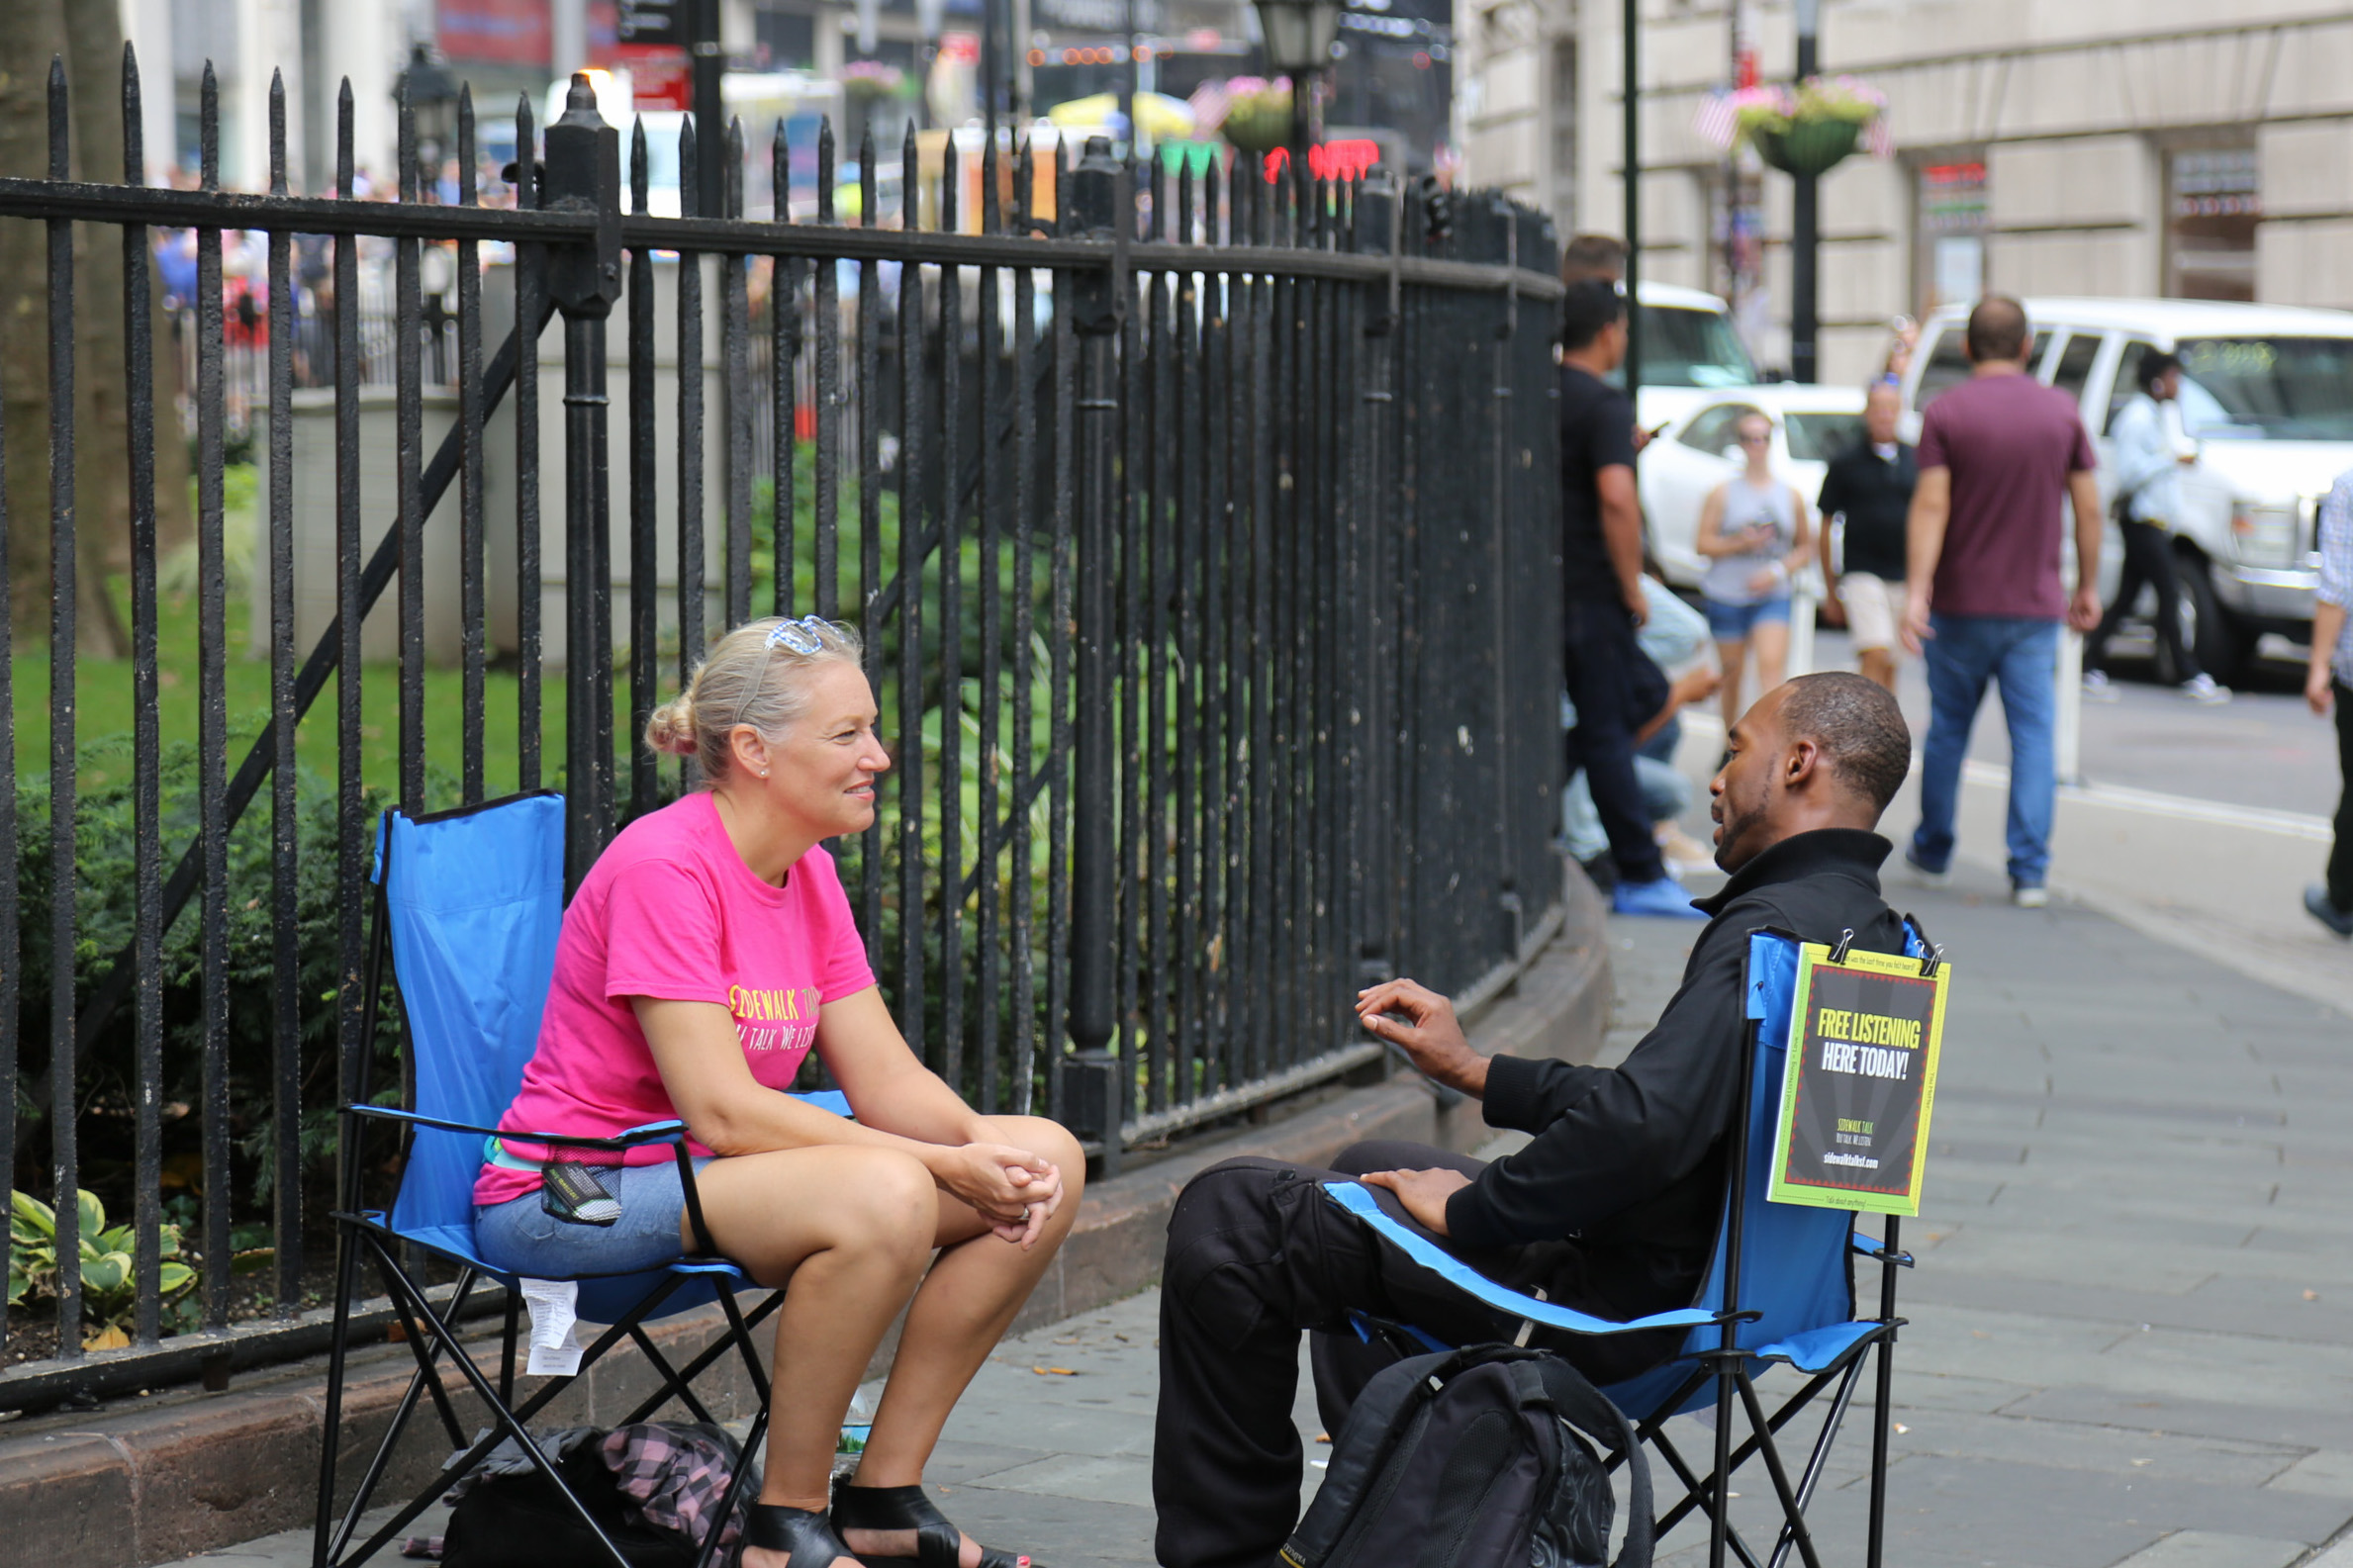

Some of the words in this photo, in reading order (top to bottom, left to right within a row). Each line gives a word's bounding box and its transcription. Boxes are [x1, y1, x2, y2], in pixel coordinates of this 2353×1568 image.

[728, 984, 800, 1021] SIDEWALK
[749, 1027, 778, 1051] TALK
[780, 1024, 796, 1051] WE
[1817, 1008, 1851, 1041] FREE
[1851, 1012, 1922, 1049] LISTENING
[1821, 1042, 1857, 1074] HERE
[1859, 1046, 1910, 1080] TODAY!
[1837, 1118, 1861, 1134] SIDEWALK
[1862, 1121, 1874, 1135] TALK
[1824, 1152, 1878, 1169] sidewalktalksf.com
